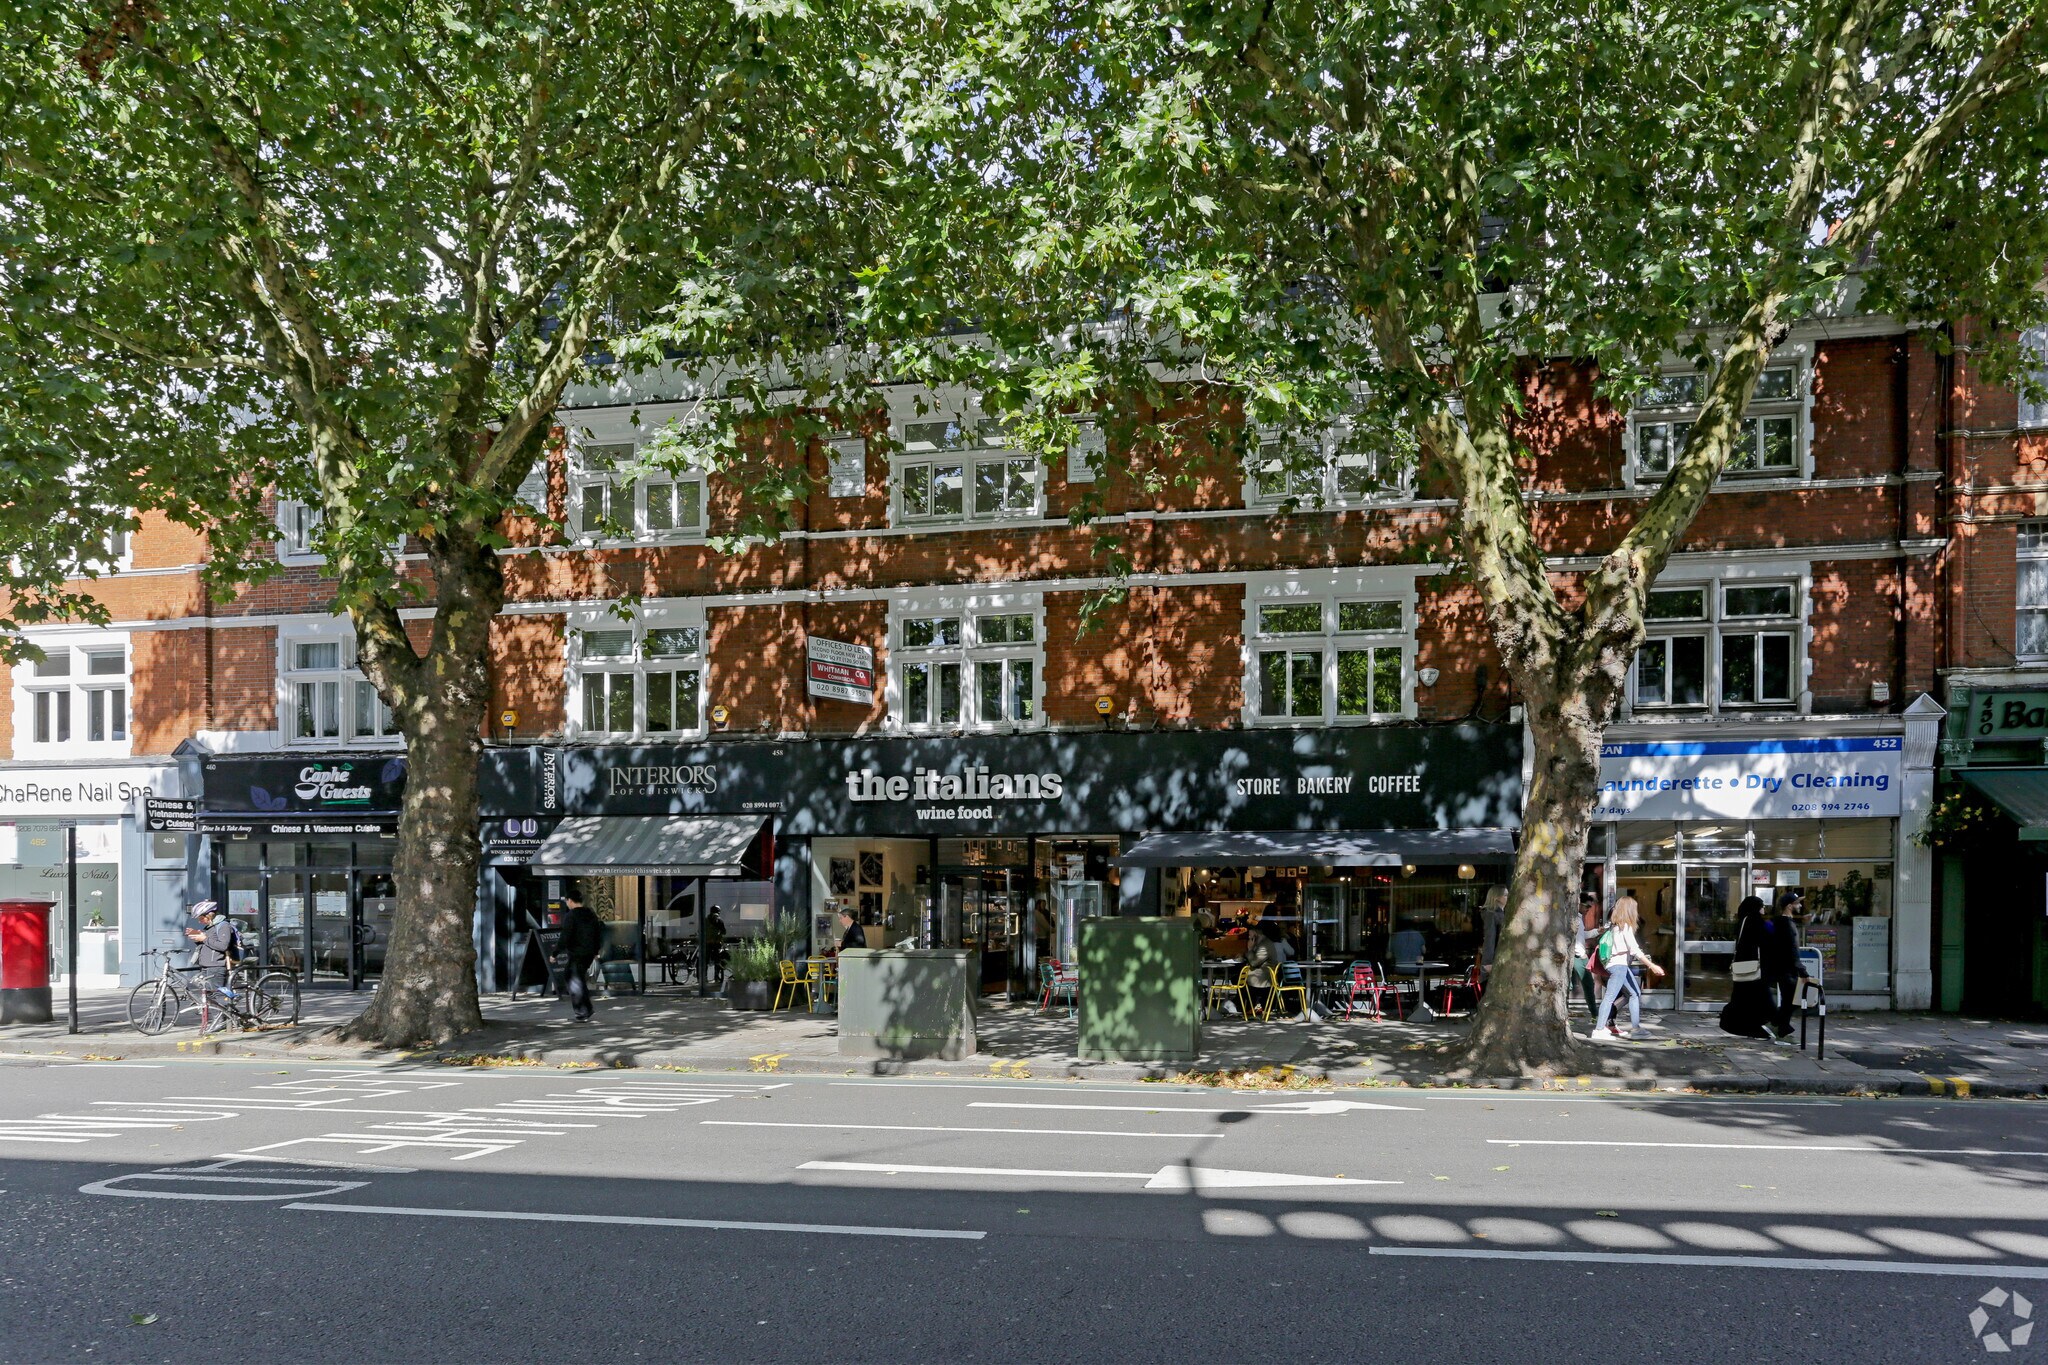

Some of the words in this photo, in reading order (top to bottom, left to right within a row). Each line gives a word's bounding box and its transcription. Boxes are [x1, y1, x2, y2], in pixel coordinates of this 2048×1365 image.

[816, 639, 842, 649] OFFICES
[844, 644, 852, 652] TO
[855, 646, 864, 654] LET
[817, 663, 850, 676] WHITMAN
[816, 683, 829, 692] 020
[1979, 695, 1993, 735] 450
[1999, 701, 2048, 728] Ba
[1873, 738, 1897, 748] 452
[300, 766, 349, 786] Caphe
[544, 752, 555, 808] INTERIORS
[609, 764, 717, 796] INTERIORS
[846, 768, 909, 801] the
[913, 766, 1063, 800] italians
[1597, 775, 1722, 792] aunderette
[1746, 774, 1782, 793] Dry
[1791, 772, 1889, 791] Cleaning
[78, 782, 112, 801] Nail
[118, 781, 152, 805] Spa
[319, 784, 372, 799] Guests
[639, 787, 701, 795] CHISWICK
[1237, 778, 1280, 796] STORE
[1297, 776, 1352, 795] BAKERY
[1368, 775, 1421, 793] COFFEE
[147, 800, 183, 809] Chinese
[186, 801, 194, 810] &
[916, 806, 955, 820] wine
[957, 805, 993, 819] food
[1609, 806, 1631, 816] days
[1792, 803, 1817, 812] 0208
[1821, 803, 1841, 811] 994
[1844, 802, 1870, 811] 2746
[166, 819, 194, 828] Cuisine
[271, 825, 301, 833] Chinese
[304, 825, 310, 833] &
[313, 825, 353, 833] Vietnamese
[355, 824, 381, 832] Cuisine
[82, 869, 109, 880] Nails
[589, 867, 681, 875] www.interiorsofchiswick.co.uk
[1631, 864, 1650, 872] DRY
[78, 1112, 598, 1201] AHEAD
